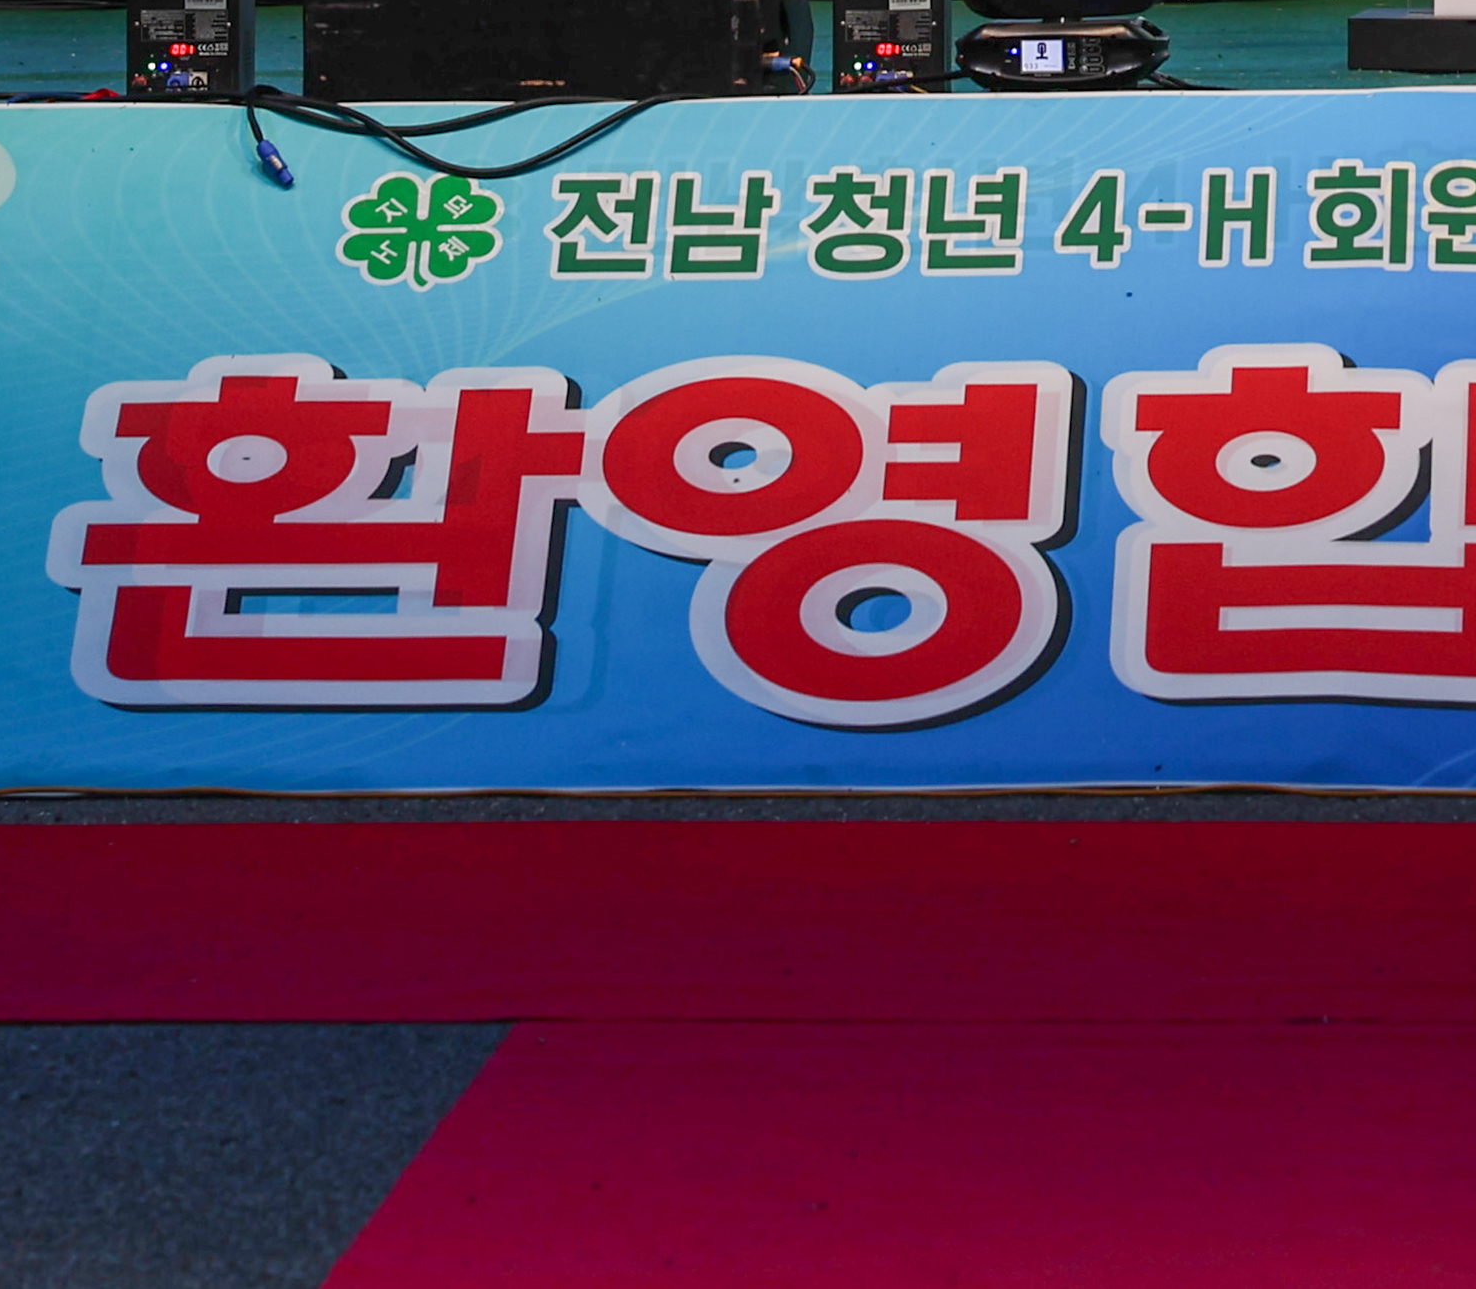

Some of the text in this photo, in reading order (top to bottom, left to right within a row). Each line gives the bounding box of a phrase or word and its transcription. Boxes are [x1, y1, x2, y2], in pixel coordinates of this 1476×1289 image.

[554, 176, 773, 275] 전남
[809, 172, 1022, 274] 청년
[1061, 173, 1270, 263] 4-H
